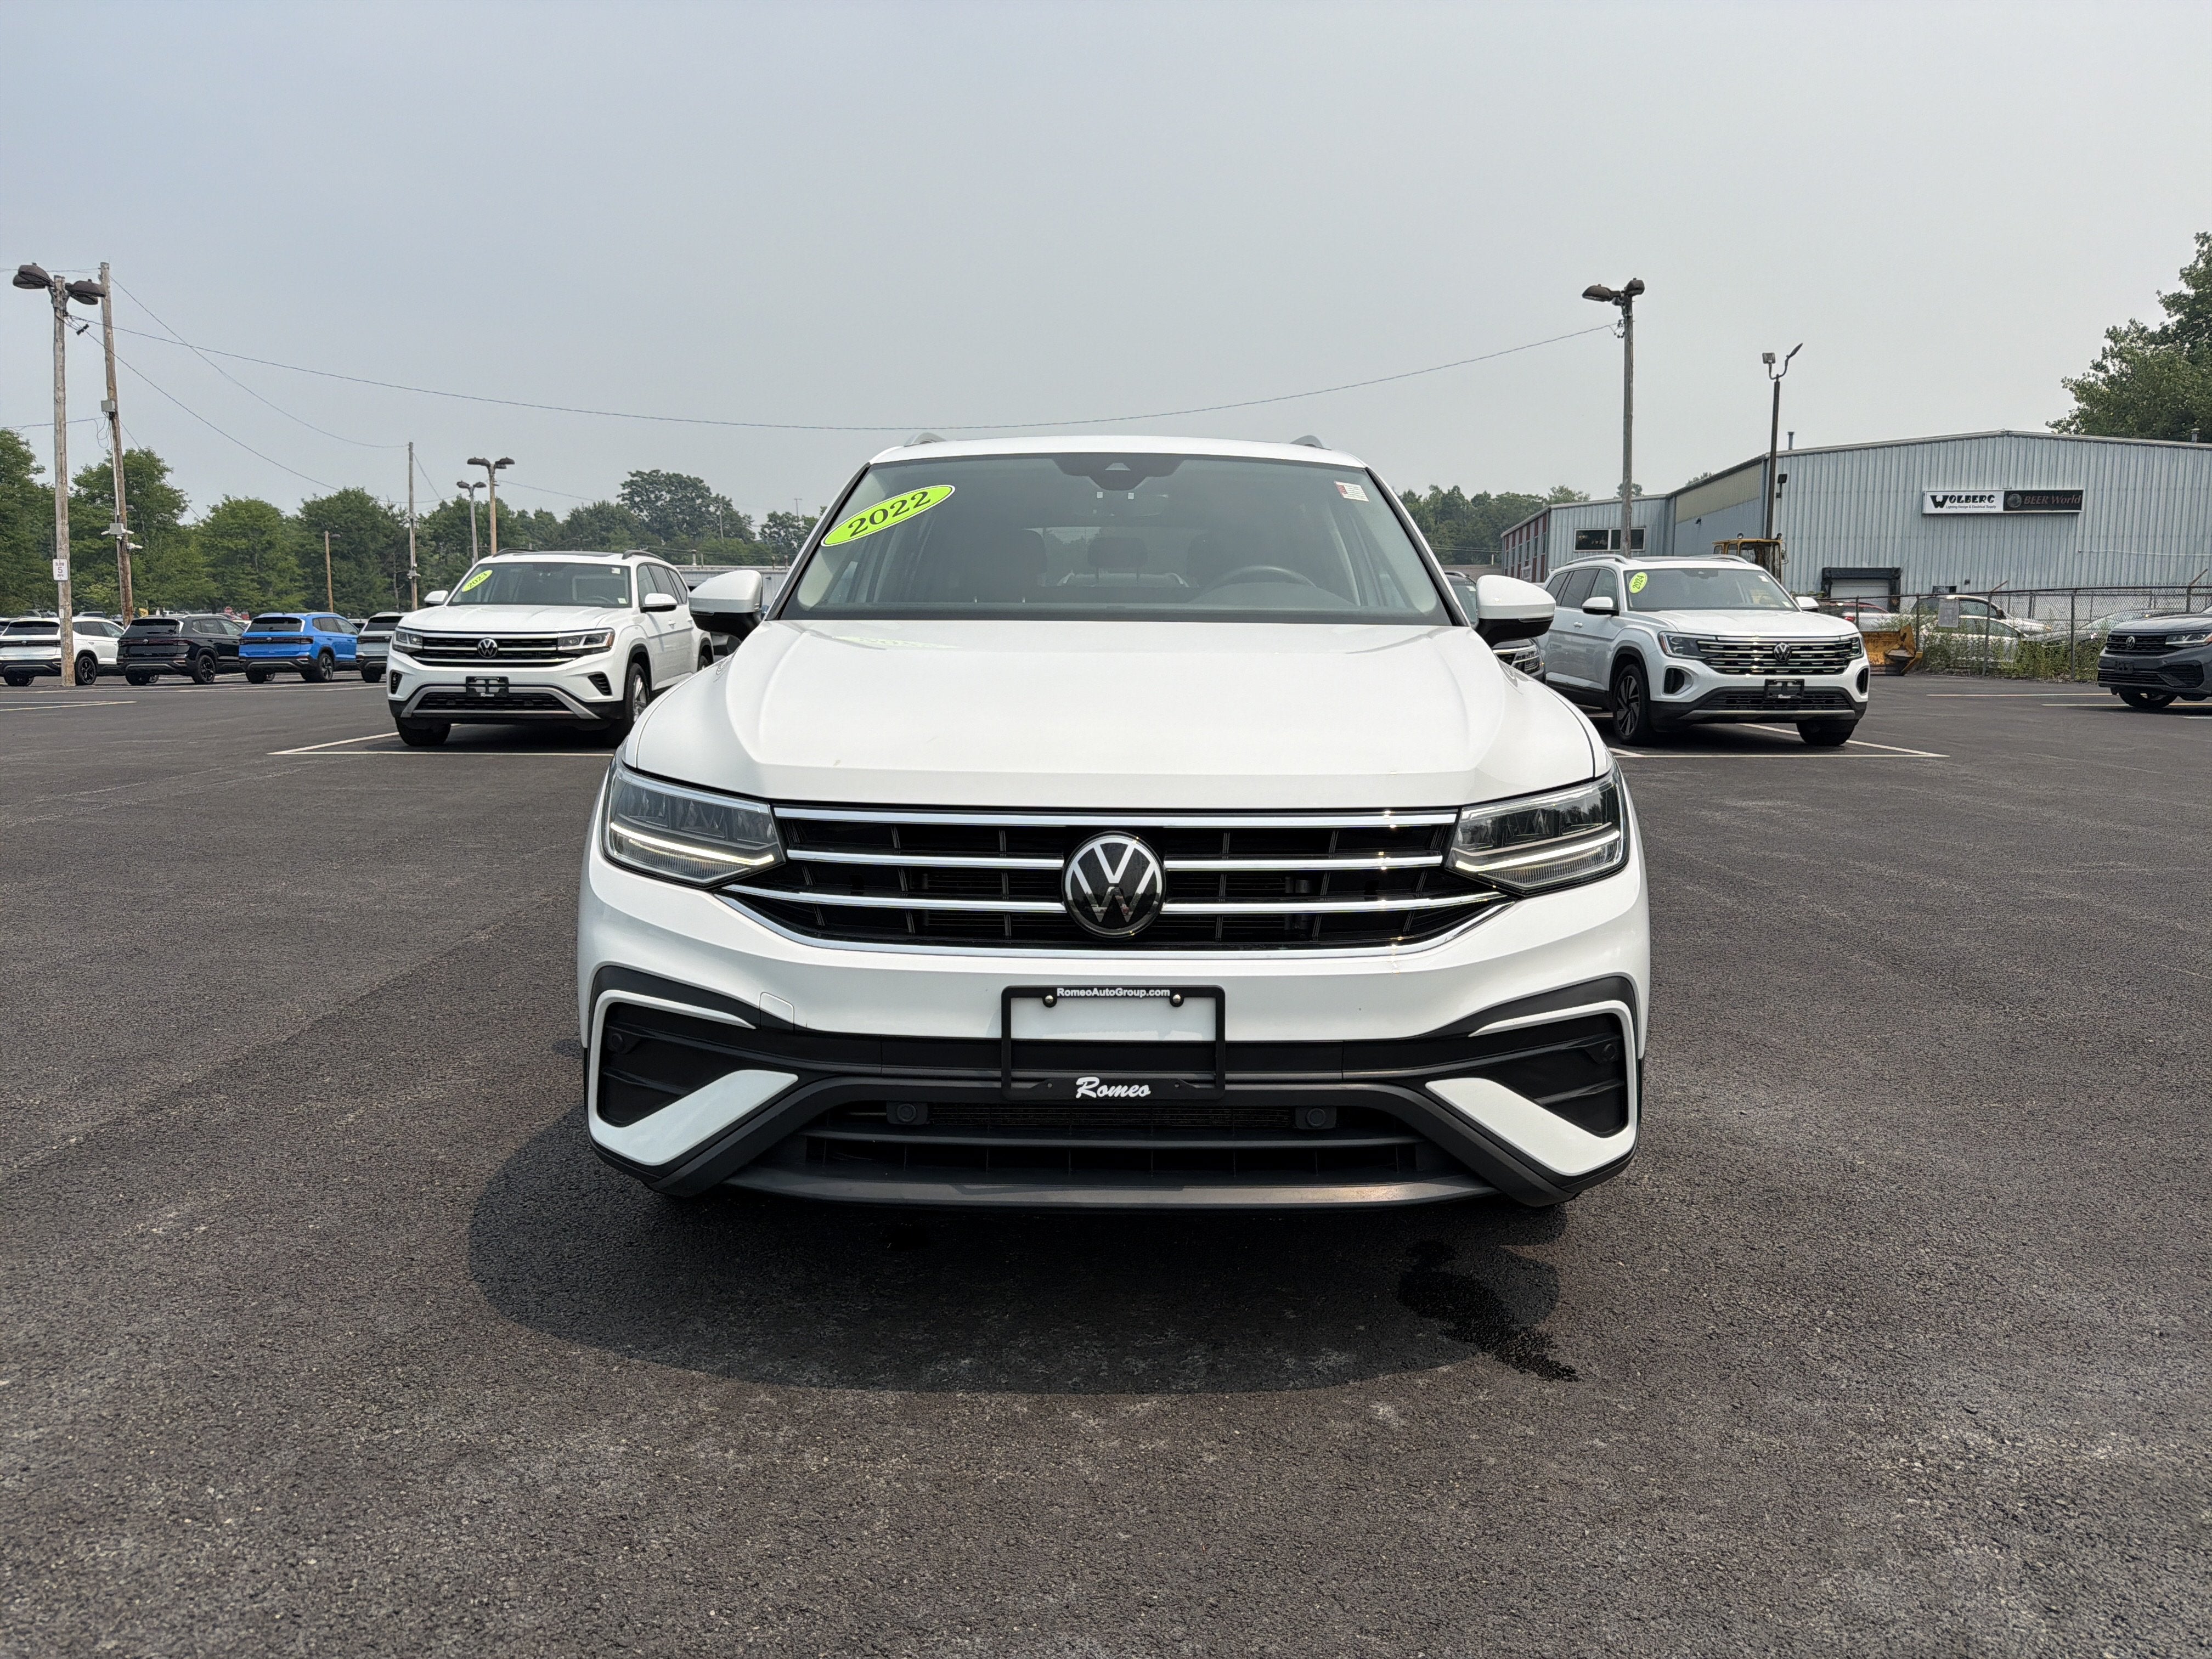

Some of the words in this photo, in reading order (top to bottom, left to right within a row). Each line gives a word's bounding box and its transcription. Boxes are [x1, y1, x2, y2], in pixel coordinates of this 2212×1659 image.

[1929, 494, 1995, 509] WOLBERG
[2024, 495, 2049, 504] BEER
[2051, 495, 2081, 504] World
[848, 491, 931, 538] 2022
[1632, 575, 1645, 590] 2024
[1068, 837, 1160, 931] VW
[1056, 987, 1171, 998] RomeoAutoGroup.com
[1076, 1076, 1151, 1098] Romeo
